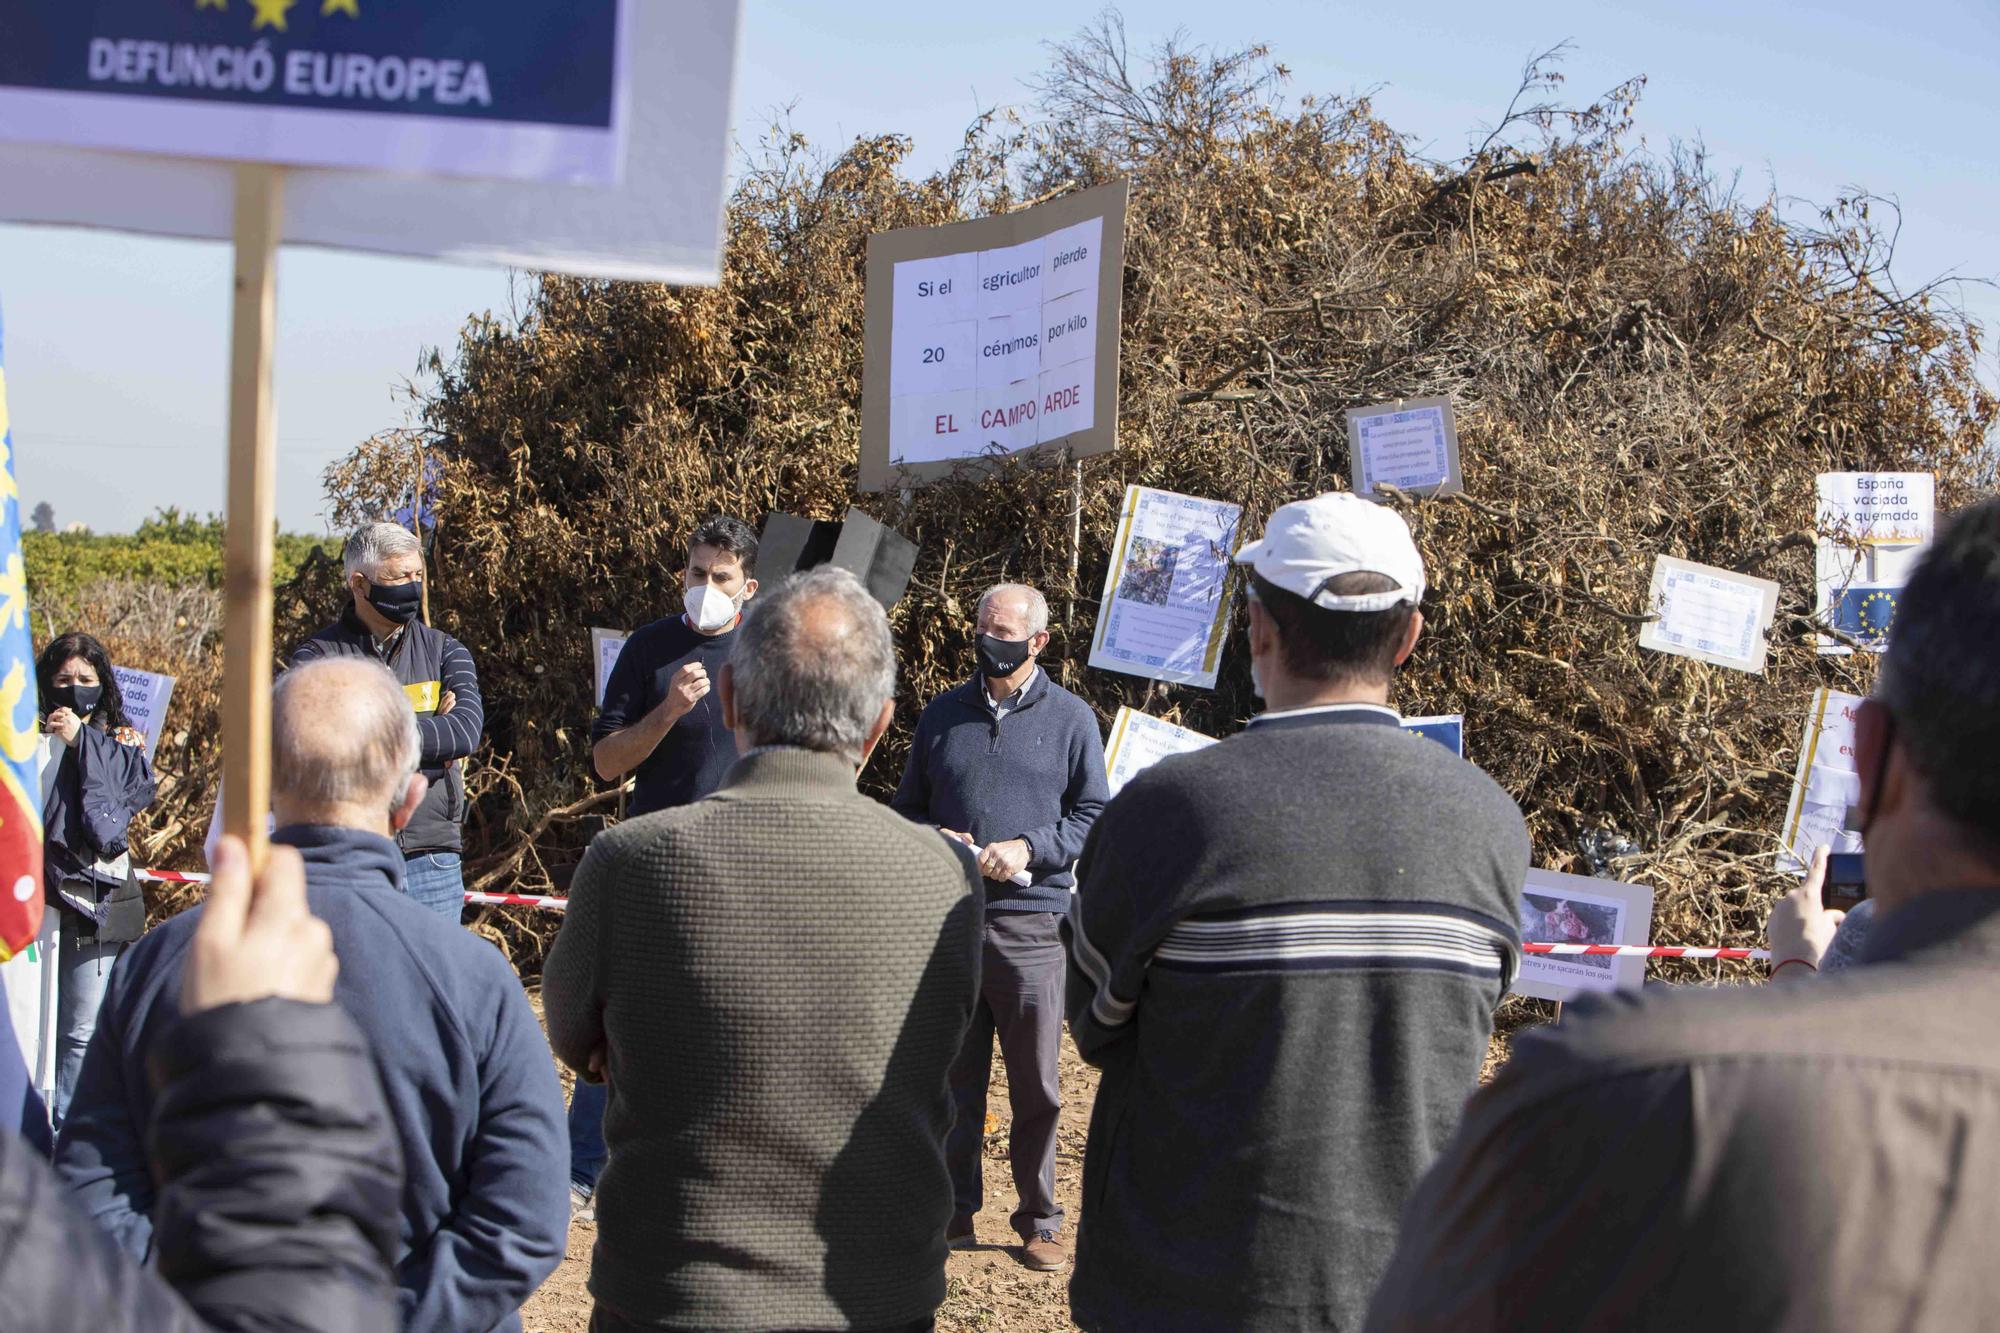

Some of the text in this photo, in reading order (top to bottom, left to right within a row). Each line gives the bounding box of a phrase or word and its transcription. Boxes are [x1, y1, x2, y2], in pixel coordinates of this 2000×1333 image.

[88, 38, 493, 107] DEFUNCIÓ EUROPEA
[917, 246, 1088, 297] Si el agricultor pierde
[922, 314, 1087, 364] 20 céntimos por kilo
[935, 385, 1080, 434] EL CAMPO ARDE
[1853, 494, 1908, 506] vaciada
[1857, 477, 1904, 491] España
[1854, 510, 1918, 523] quemada
[116, 670, 149, 687] España
